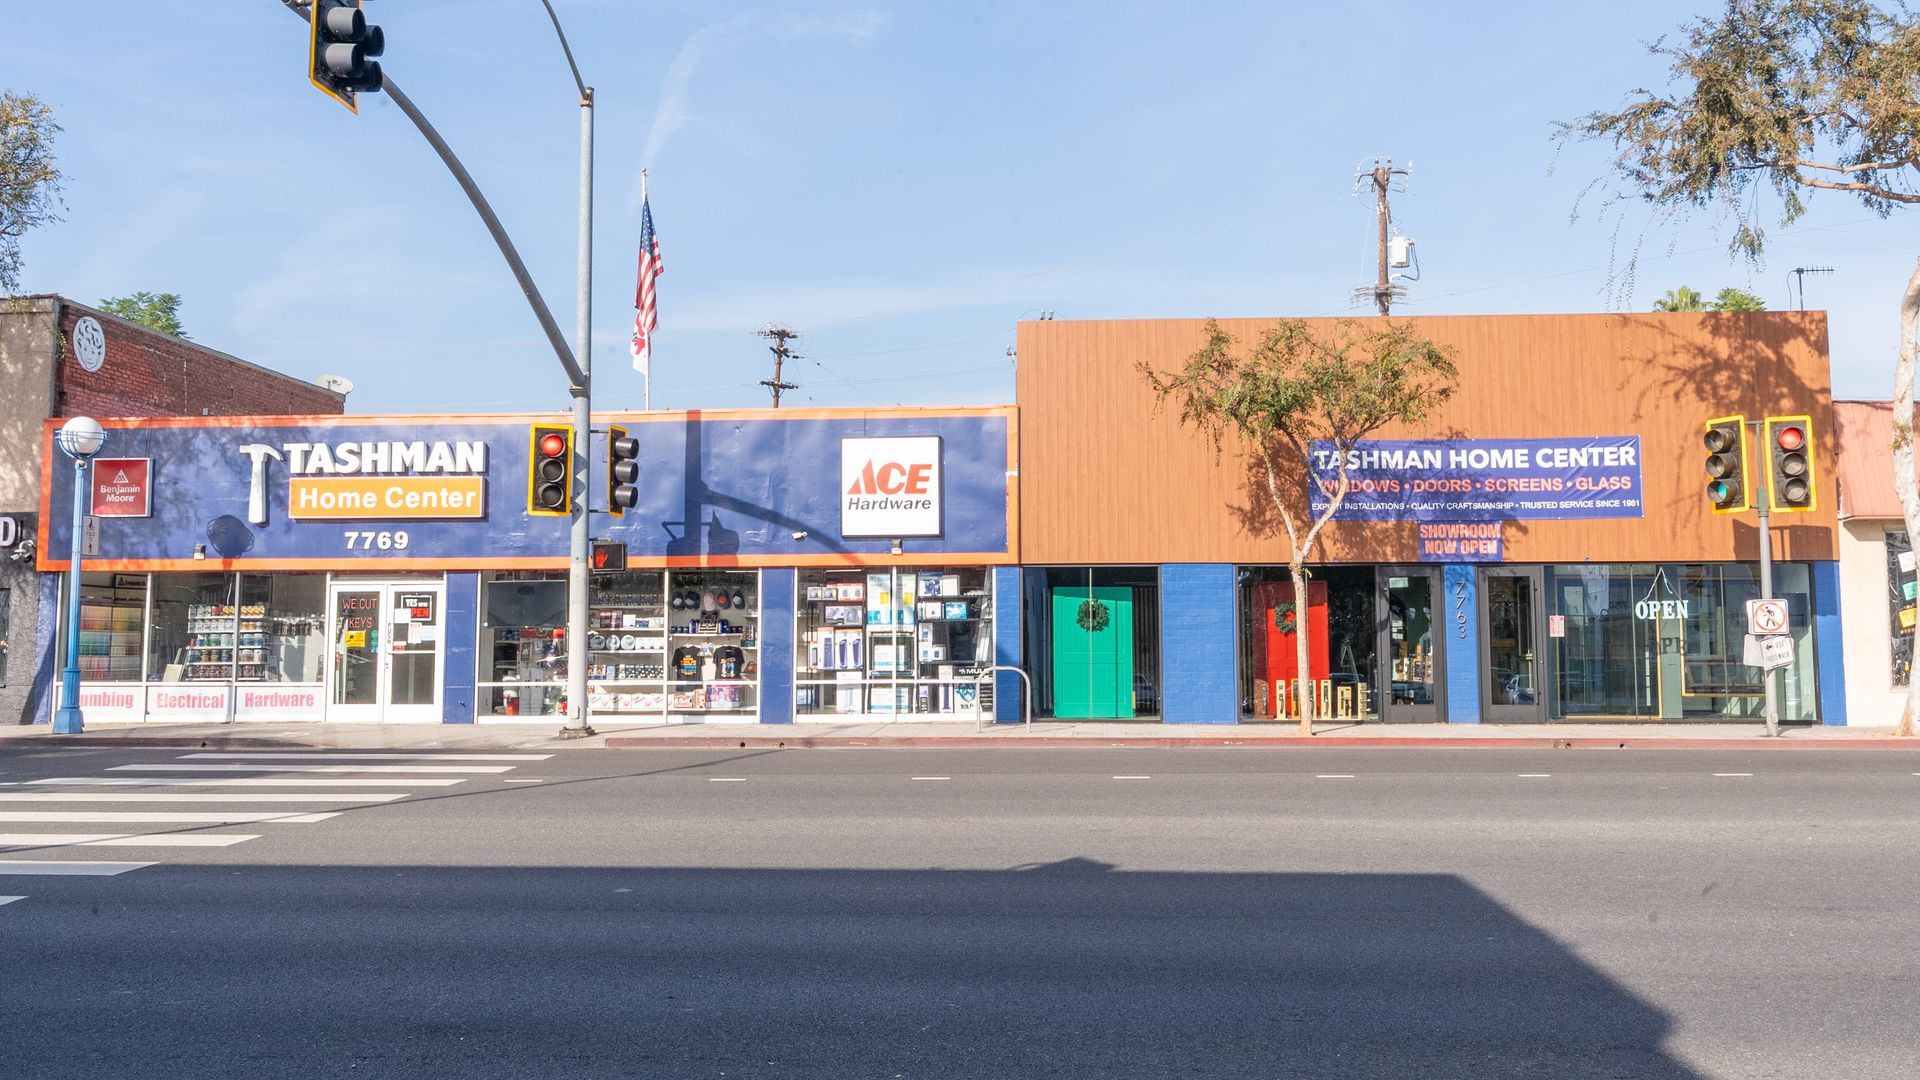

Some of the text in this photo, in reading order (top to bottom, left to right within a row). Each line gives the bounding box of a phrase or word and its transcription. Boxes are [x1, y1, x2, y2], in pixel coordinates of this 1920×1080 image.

[283, 441, 486, 474] TASHMAN
[1314, 446, 1637, 470] TASHMAN HOME CENTER
[847, 457, 933, 495] ACE
[100, 485, 140, 495] Benjamin
[1413, 478, 1472, 493] DOORS
[1485, 476, 1563, 492] SCREENS
[1575, 475, 1632, 491] GLASS
[106, 494, 135, 503] Moore
[300, 486, 476, 509] Home Center
[848, 497, 932, 511] Hardware
[1312, 499, 1640, 511] EXPT INSTALLATIONS QUALITY CRAFTSMANSHIP TRUSTED SERVICE SINCE 1961
[1420, 523, 1501, 538] SHOWROOM
[344, 531, 409, 550] 7769
[1425, 540, 1498, 555] NOW OPEN
[342, 598, 377, 609] WE CUT
[405, 598, 418, 608] YES
[1456, 580, 1467, 639] 7763
[1635, 600, 1689, 620] OPEN
[411, 607, 429, 618] PEN
[349, 616, 373, 628] KEYS
[80, 691, 314, 710] umbing Electrical Hardware
